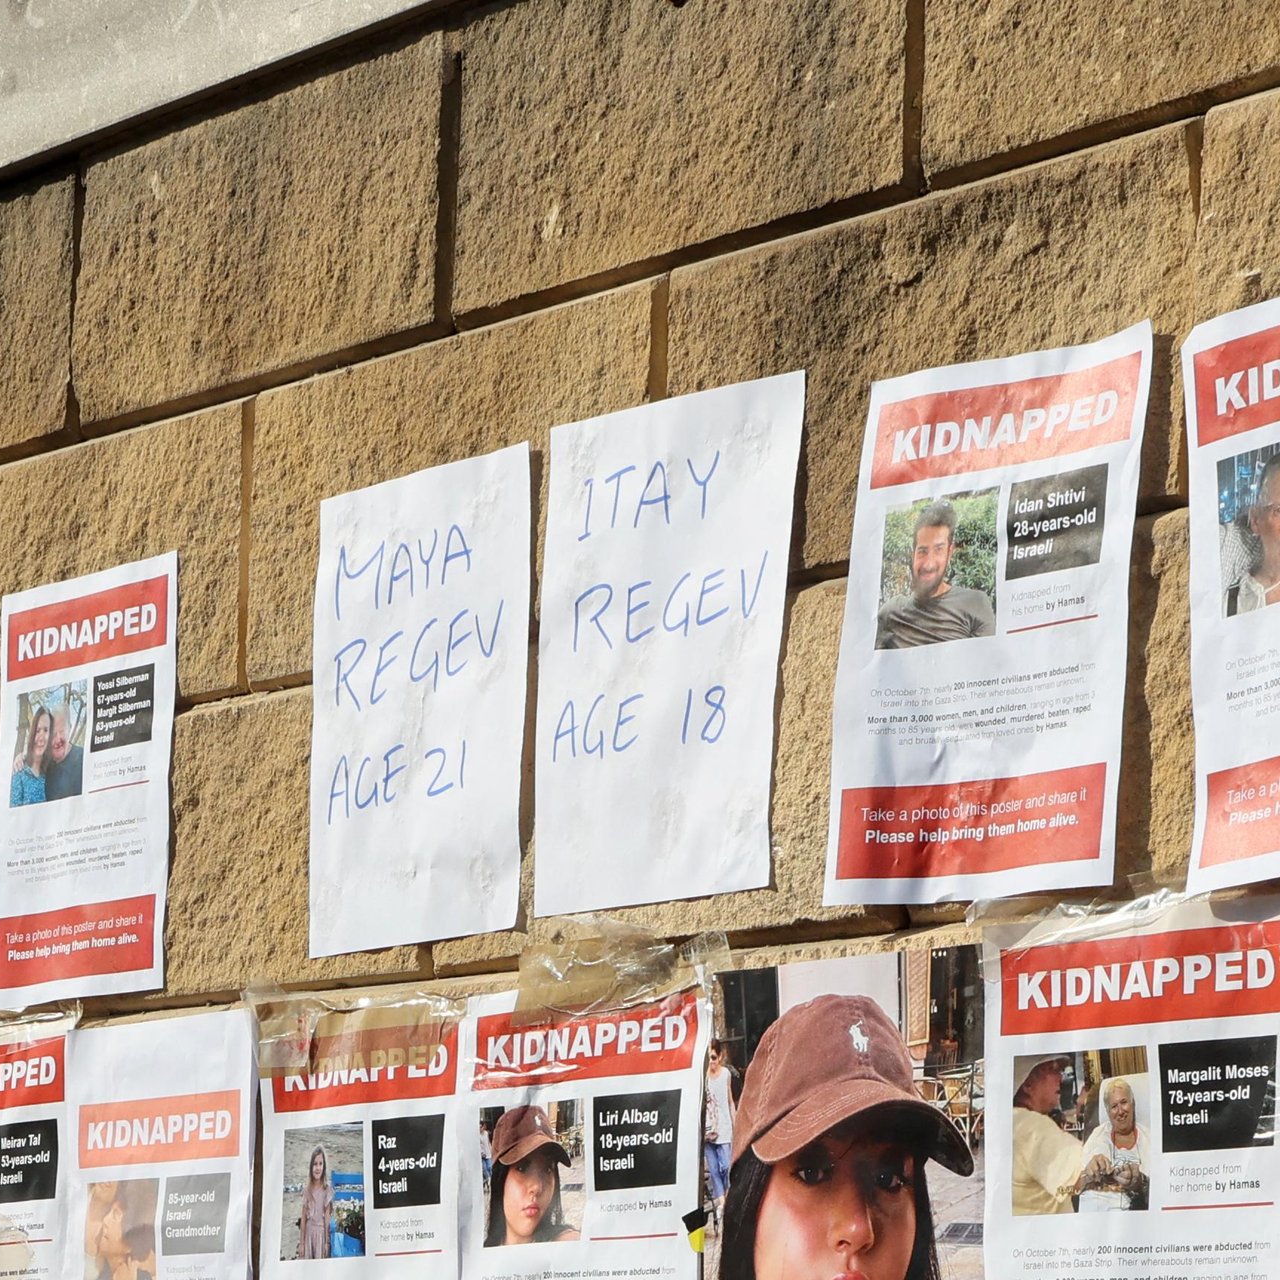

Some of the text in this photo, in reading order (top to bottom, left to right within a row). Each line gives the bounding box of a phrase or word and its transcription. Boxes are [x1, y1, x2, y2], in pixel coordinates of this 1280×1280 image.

[888, 382, 1121, 467] KIDNAPPED
[578, 450, 720, 542] ITAY
[1015, 486, 1085, 514] Idan Shtivi
[1014, 507, 1096, 537] 28-years-old
[335, 524, 472, 619] MAYA
[573, 550, 767, 652] REGEV
[18, 603, 157, 661] KIDNAPPED
[334, 602, 504, 711] REGEV
[553, 685, 726, 762] AGE 18
[328, 740, 466, 824] AGE 21
[1018, 949, 1275, 1010] KIDNAPPED
[487, 1015, 688, 1070] KIDNAPPED
[1168, 1065, 1269, 1085] Margalit Moses
[1169, 1085, 1250, 1107] 78-years-old
[87, 1110, 232, 1150] KIDNAPPED
[599, 1109, 658, 1126] Liri Albag
[600, 1128, 673, 1151] 18-years-old
[378, 1135, 397, 1149] Raz
[168, 1190, 215, 1206] 85-year-old
[165, 1224, 221, 1238] Grandmother
